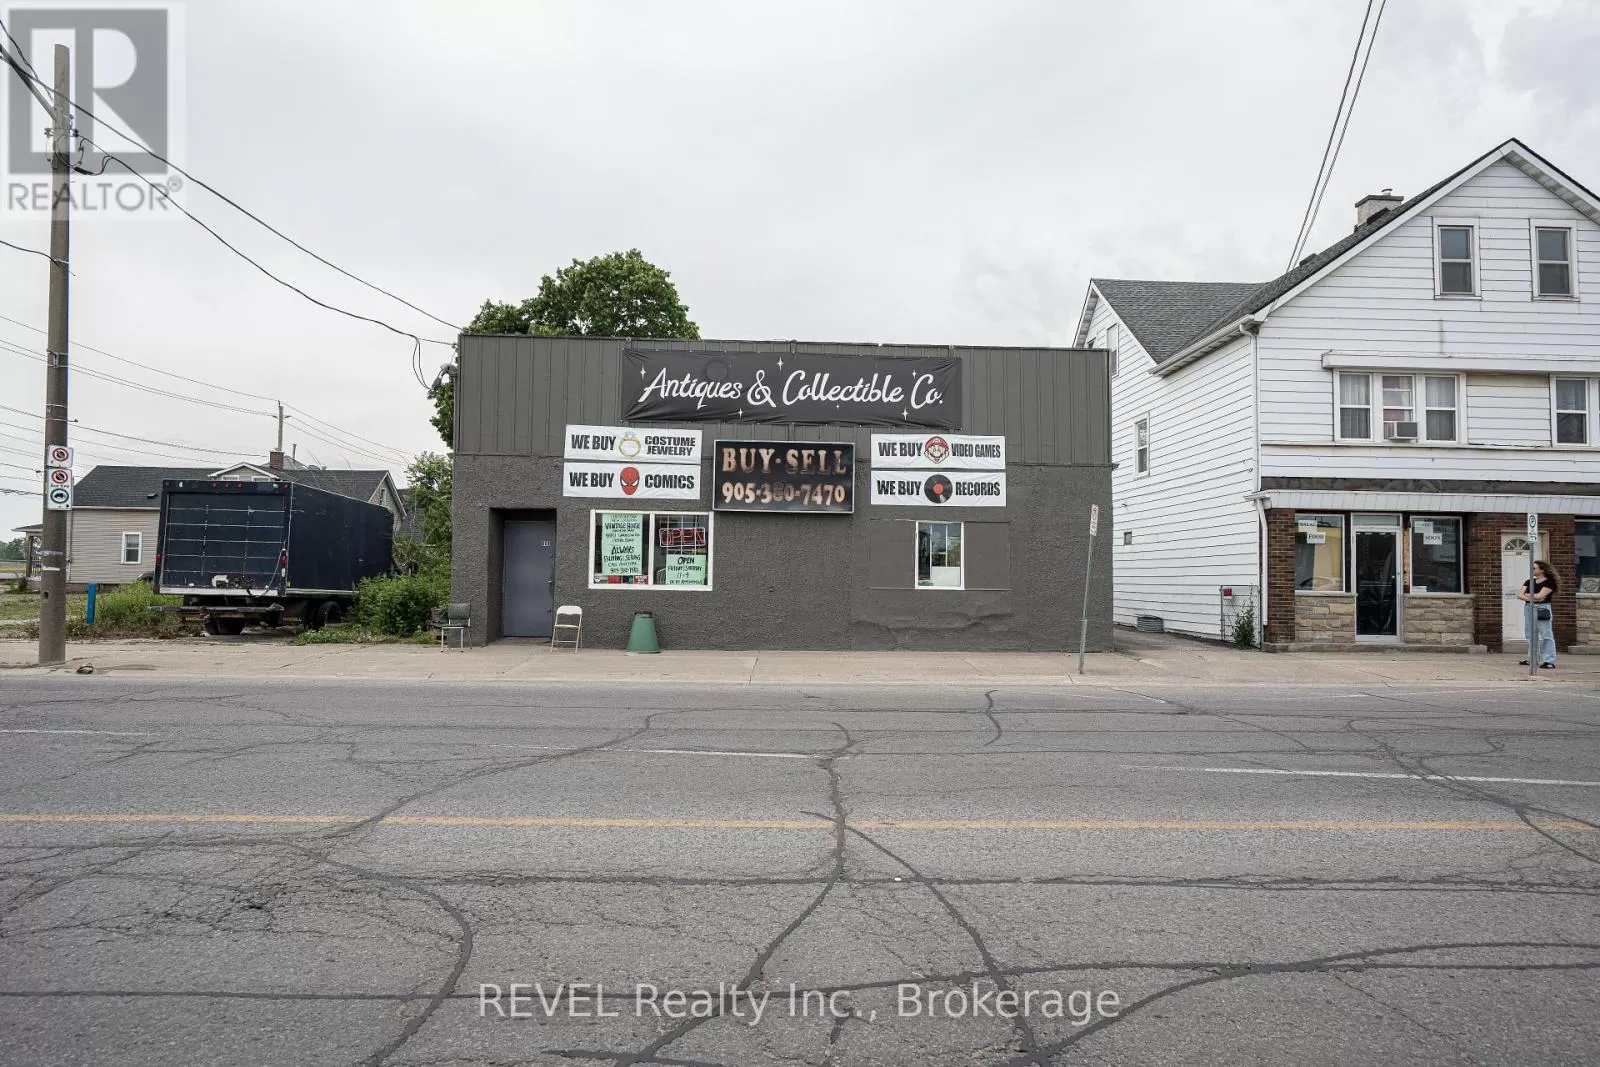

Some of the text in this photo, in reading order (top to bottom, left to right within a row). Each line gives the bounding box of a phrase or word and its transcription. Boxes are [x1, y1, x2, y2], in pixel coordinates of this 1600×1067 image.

[638, 367, 943, 410] Antiques & Collectible Co.
[571, 434, 616, 450] WE BUY
[645, 435, 696, 447] COSTUME
[646, 446, 693, 456] JEWELRY
[878, 442, 1001, 458] WE BUY VIDEO GAMES
[569, 472, 695, 489] WE BUY COMICS
[877, 480, 1000, 496] WE BUY RECORDS
[661, 528, 705, 546] OPEN
[677, 556, 695, 565] OPEN
